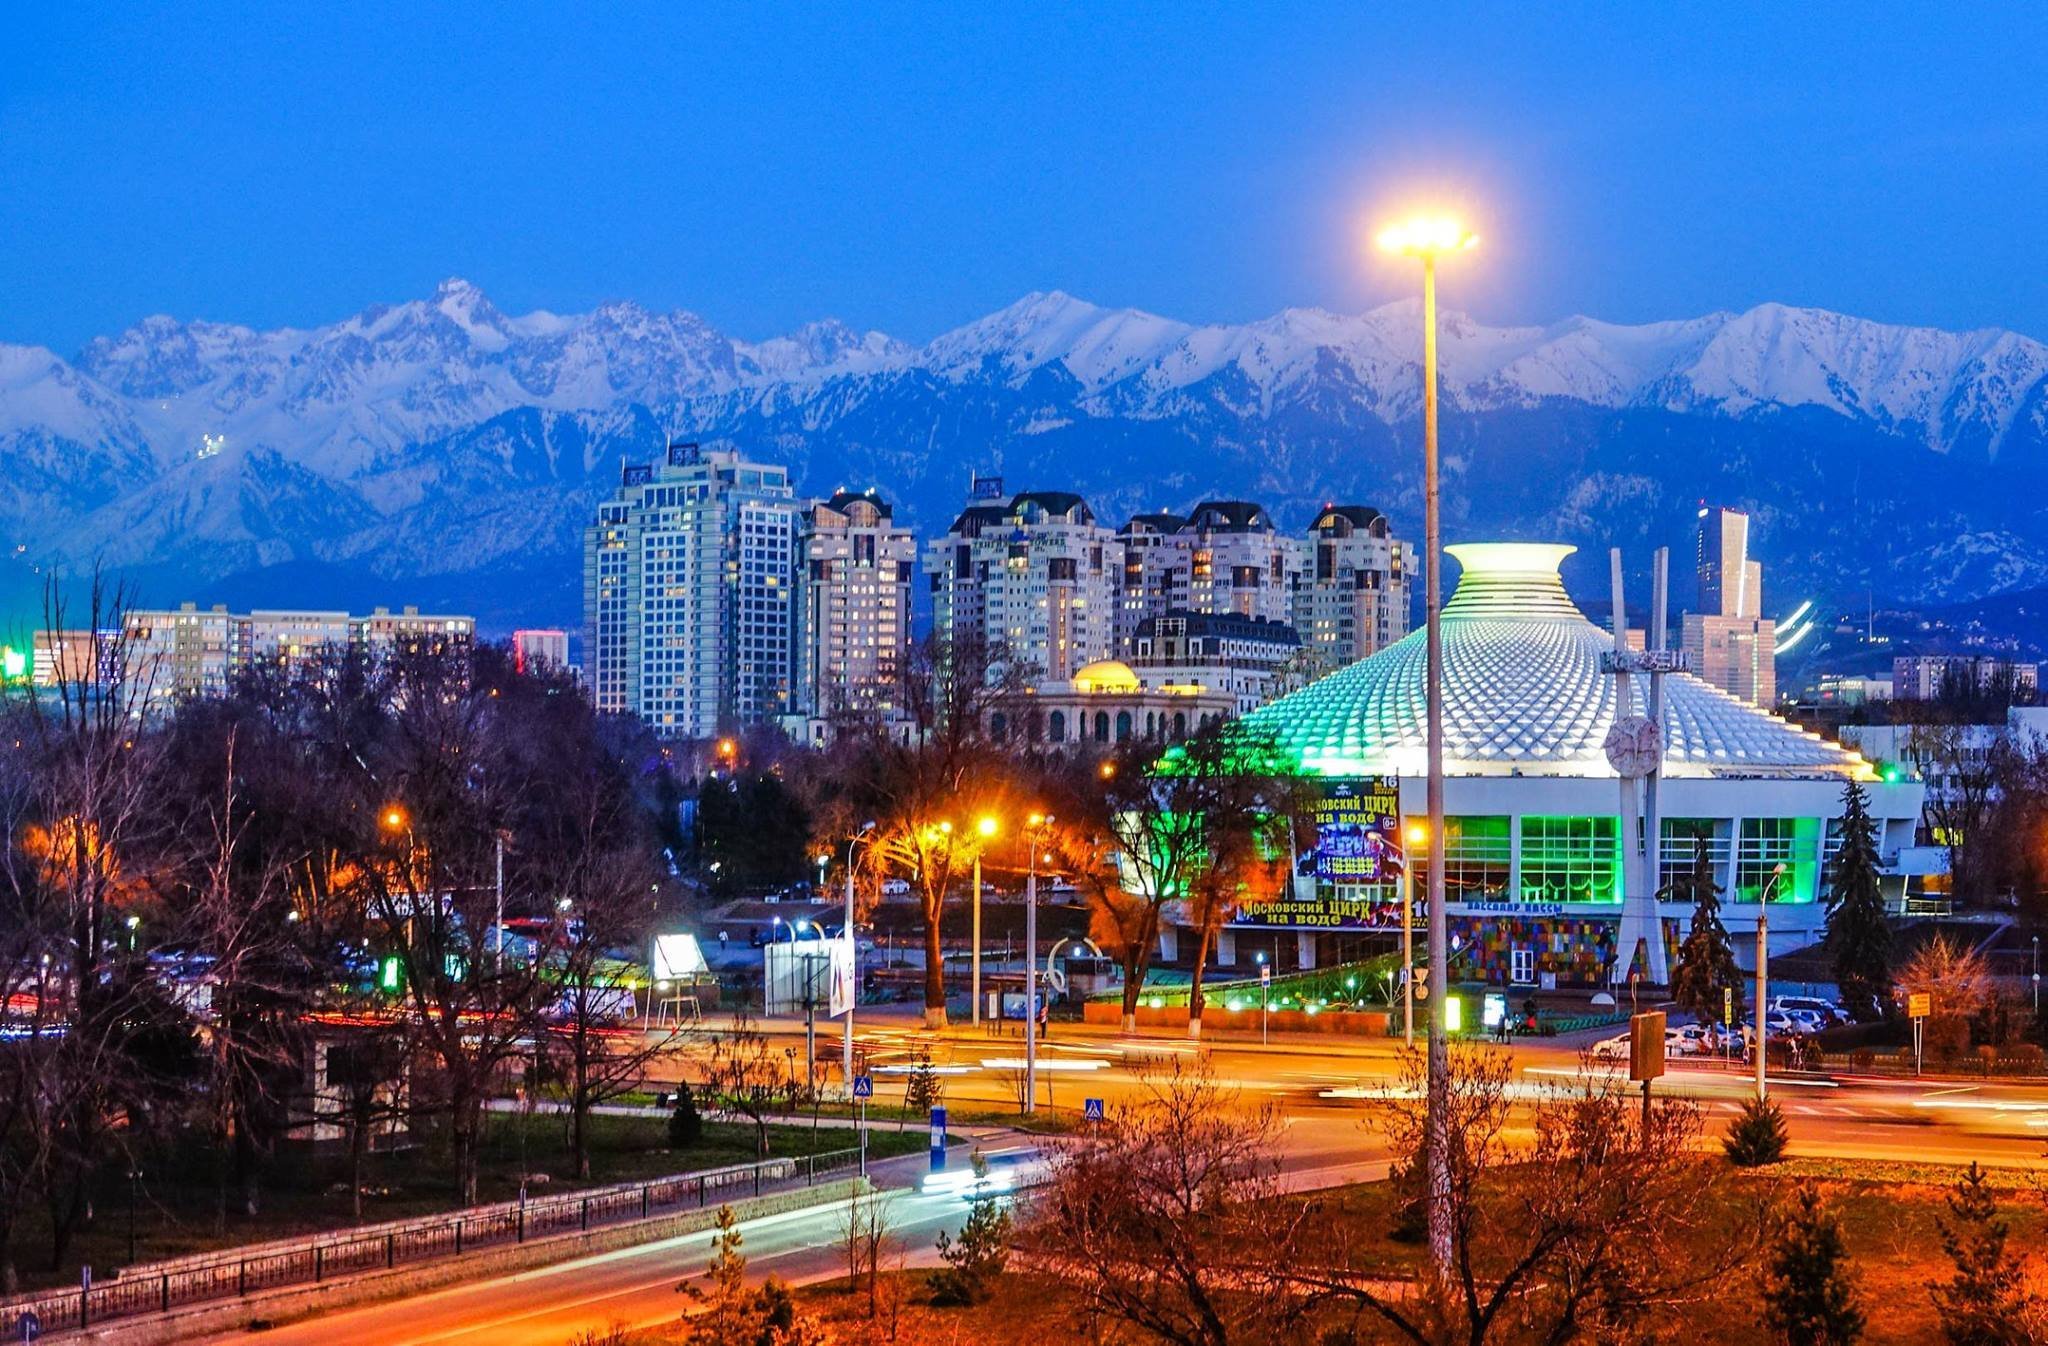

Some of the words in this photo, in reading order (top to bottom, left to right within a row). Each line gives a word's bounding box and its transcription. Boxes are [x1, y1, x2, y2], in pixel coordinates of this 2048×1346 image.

[1381, 776, 1398, 788] 16
[1364, 795, 1397, 816] ЦИРК
[1315, 813, 1334, 823] на
[1339, 813, 1376, 825] воде
[1329, 901, 1371, 920] ЦИРК
[1525, 903, 1563, 913] КАССЫ
[1266, 913, 1289, 924] на
[1296, 913, 1342, 926] воде
